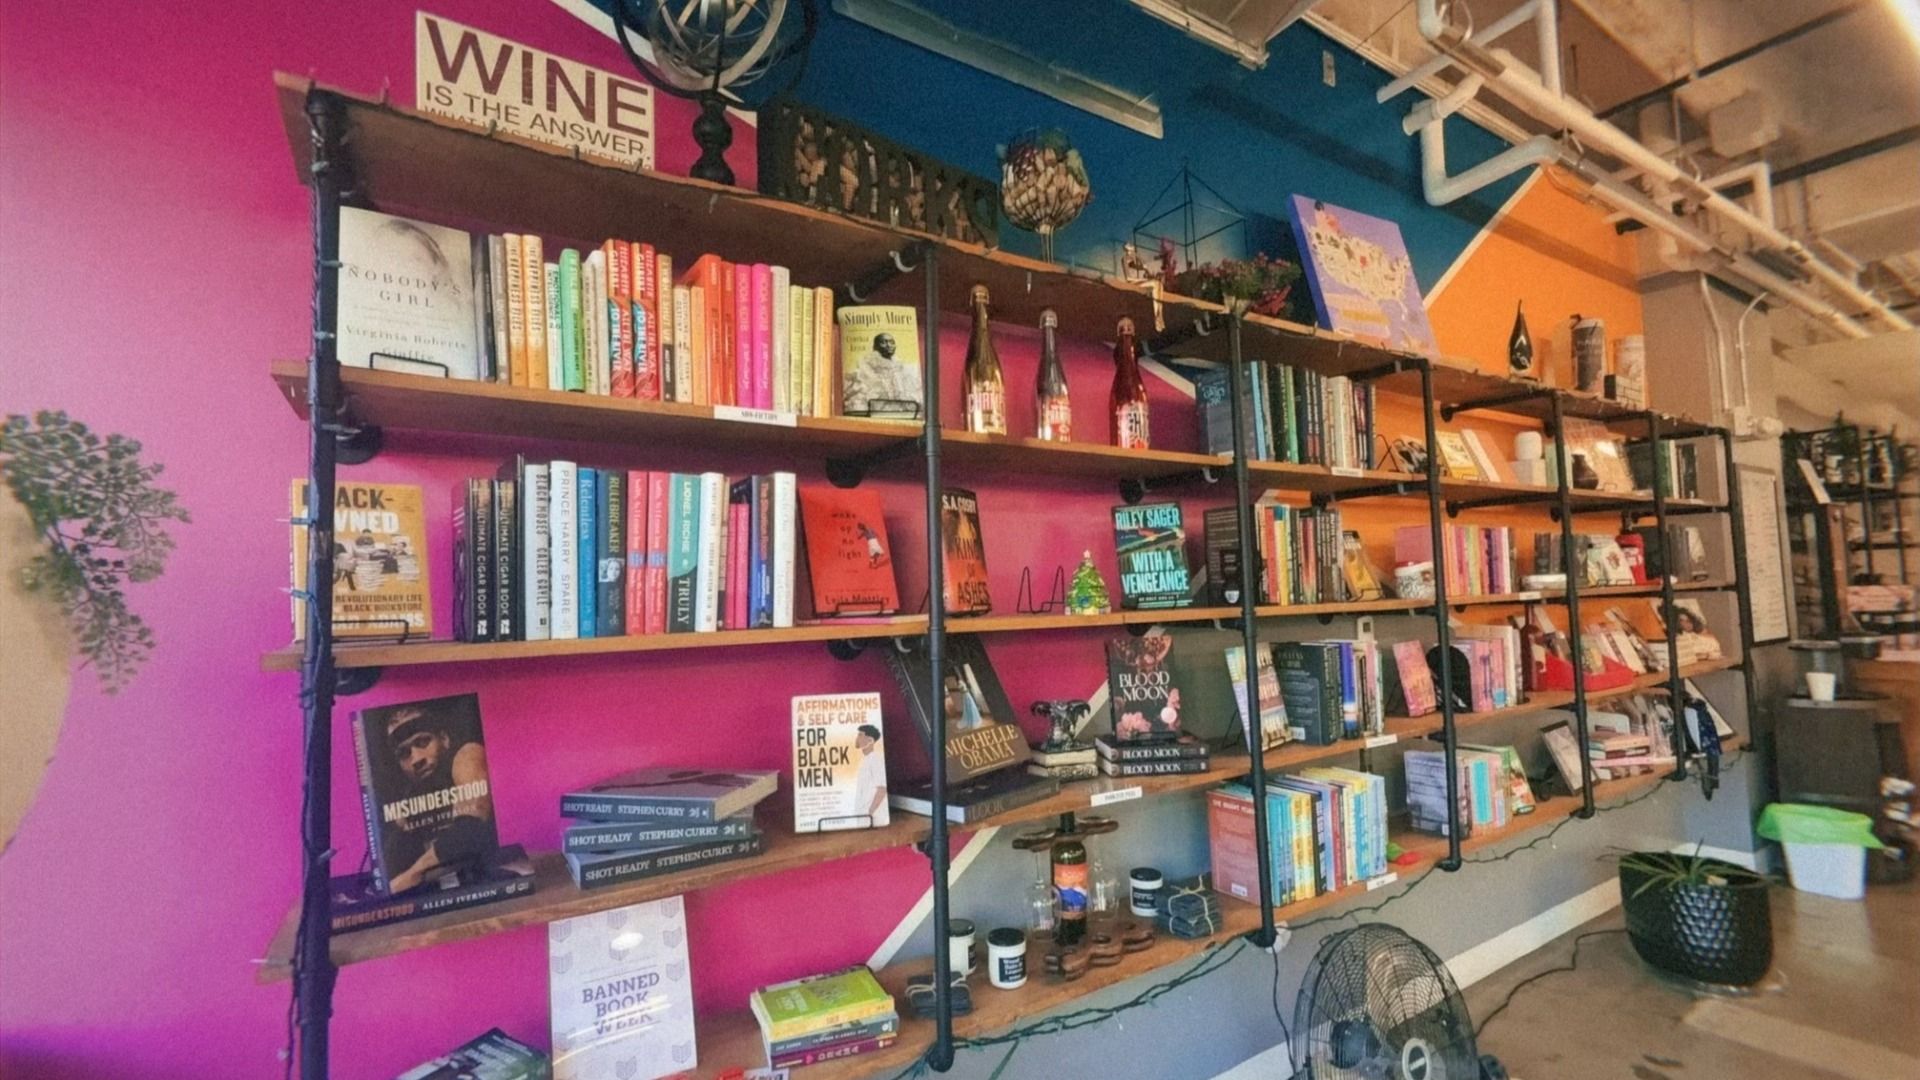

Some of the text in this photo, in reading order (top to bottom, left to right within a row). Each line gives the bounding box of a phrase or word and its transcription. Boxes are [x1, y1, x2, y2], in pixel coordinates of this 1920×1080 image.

[425, 17, 649, 138] WINE
[426, 81, 651, 160] IS THE ANSWER.
[349, 266, 462, 296] NOBODY'S
[379, 290, 434, 308] GIRL
[845, 312, 912, 327] Simply More
[346, 325, 408, 342] Virginia
[535, 474, 547, 535] BLACK MOSES
[580, 479, 593, 540] Relentless
[608, 476, 621, 553] RULEBREAKER
[682, 481, 692, 553] LIONEL RICHIE
[942, 495, 976, 513] S.A. COSBY
[1114, 507, 1181, 531] RILEY SAGER
[560, 469, 570, 614] PRINCE HARRY SPARE
[477, 508, 487, 616] ULTIMATE CIGAR BOOK
[500, 507, 510, 615] ULTIMATE CIGAR BOOK
[536, 547, 548, 575] CALEB
[1131, 550, 1175, 572] WITH A
[957, 581, 990, 605] ASHES
[1121, 570, 1190, 595] VENGEANCE
[677, 577, 690, 624] TRULY
[1119, 670, 1170, 688] BLOOD
[797, 697, 879, 714] AFFIRMATIONS
[1123, 686, 1169, 702] MOON
[797, 711, 868, 726] & SELF CARE
[797, 728, 827, 747] FOR
[945, 724, 1019, 758] MICHELLE
[798, 746, 850, 768] BLACK
[960, 744, 1015, 770] OBAMA
[1122, 749, 1181, 758] BLOOD MOON
[798, 768, 833, 789] MEN
[1123, 763, 1181, 774] BLOOD MOON
[383, 779, 489, 823] MISUNDERSTOOD
[563, 803, 685, 817] SHOT READY STEPHEN CURRY
[403, 804, 477, 832] ALLEN IVERSON
[568, 826, 719, 846] SHOT READY STEPHEN CURRY
[585, 845, 734, 881] SHOT READY STEPHEN CURRY
[331, 889, 498, 930] MISUNDERSTOOD ALLEN IVERSON
[581, 971, 660, 1004] BANNED
[595, 991, 650, 1018] BOOK
